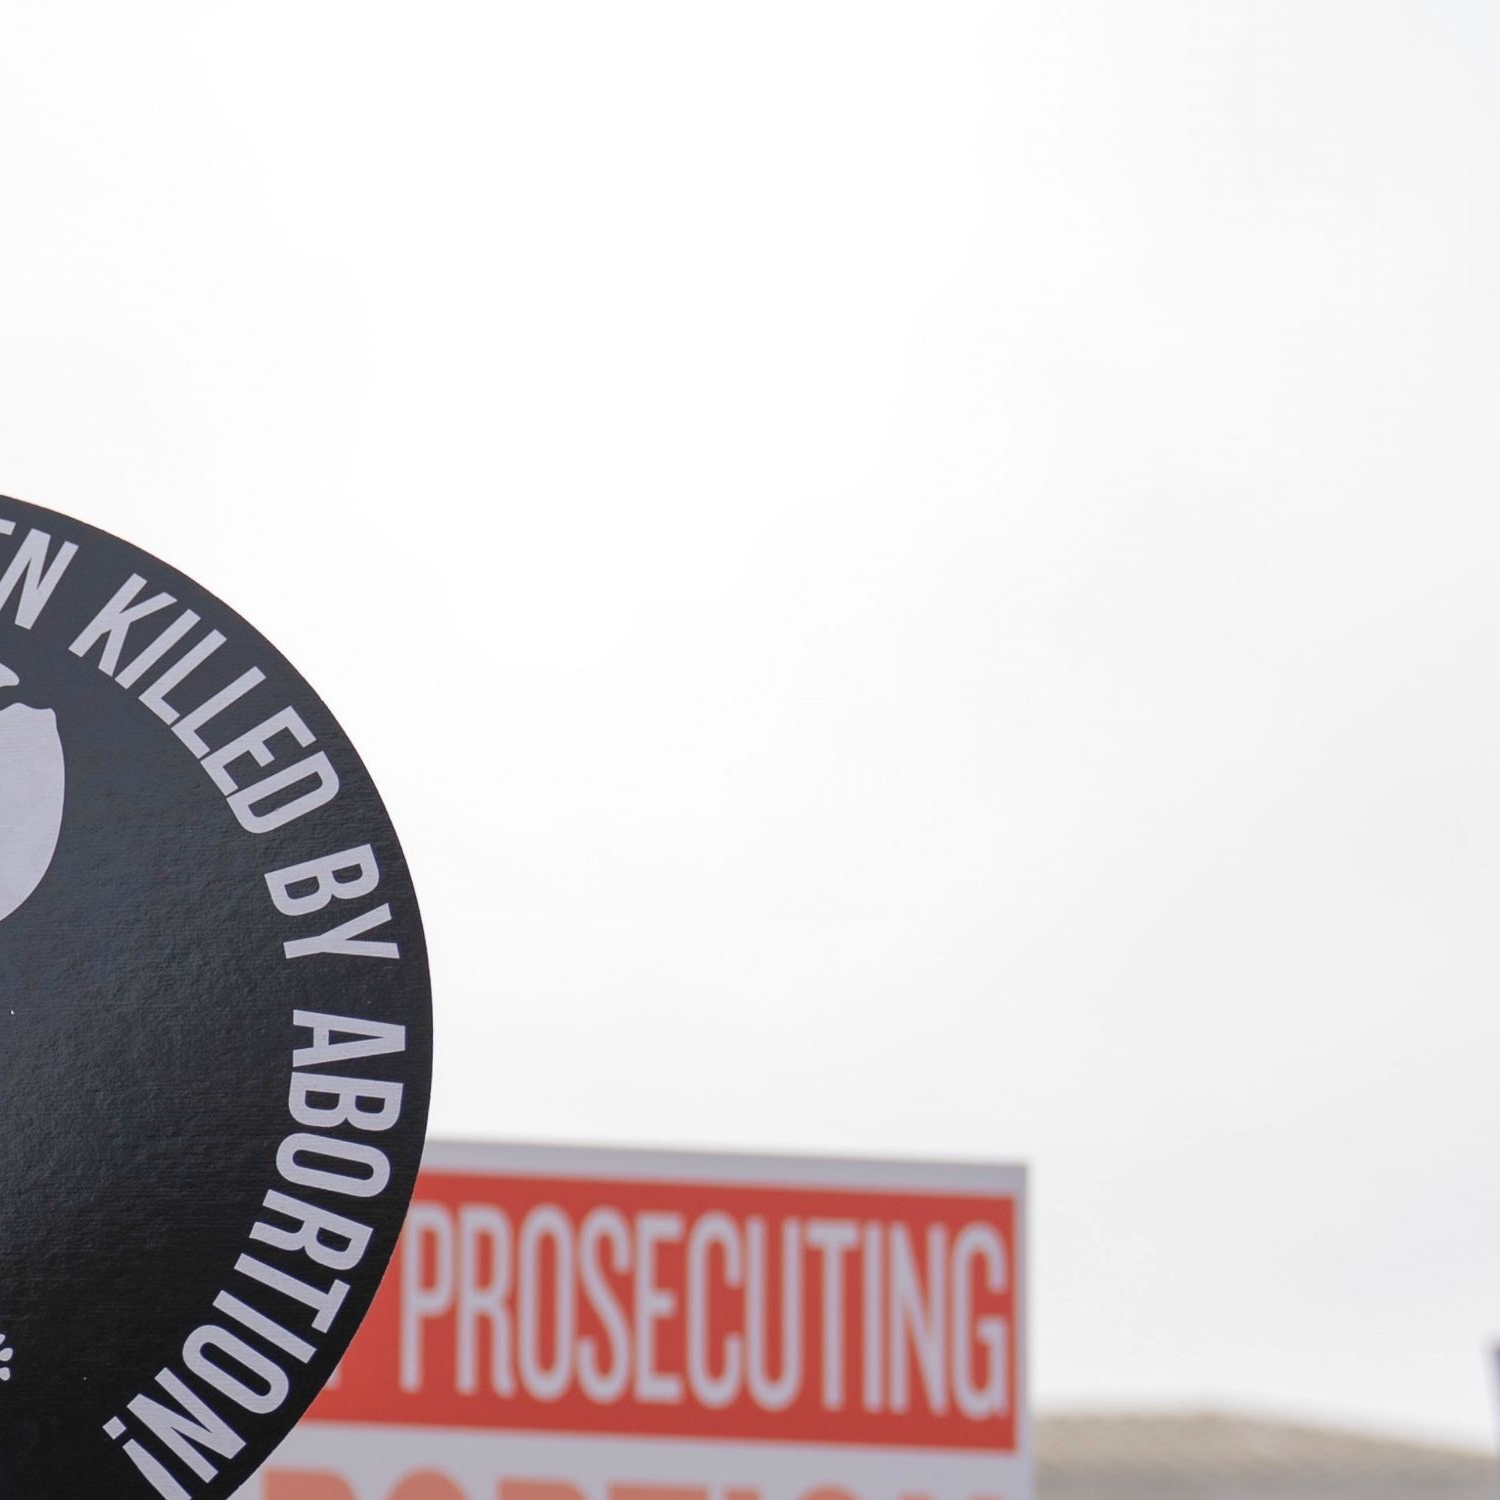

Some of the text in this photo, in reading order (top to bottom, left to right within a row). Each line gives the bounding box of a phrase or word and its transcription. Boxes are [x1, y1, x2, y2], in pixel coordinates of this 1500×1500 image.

[68, 572, 340, 833] KILLED
[264, 843, 400, 959] BY
[400, 1201, 1009, 1420] PROSECUTING
